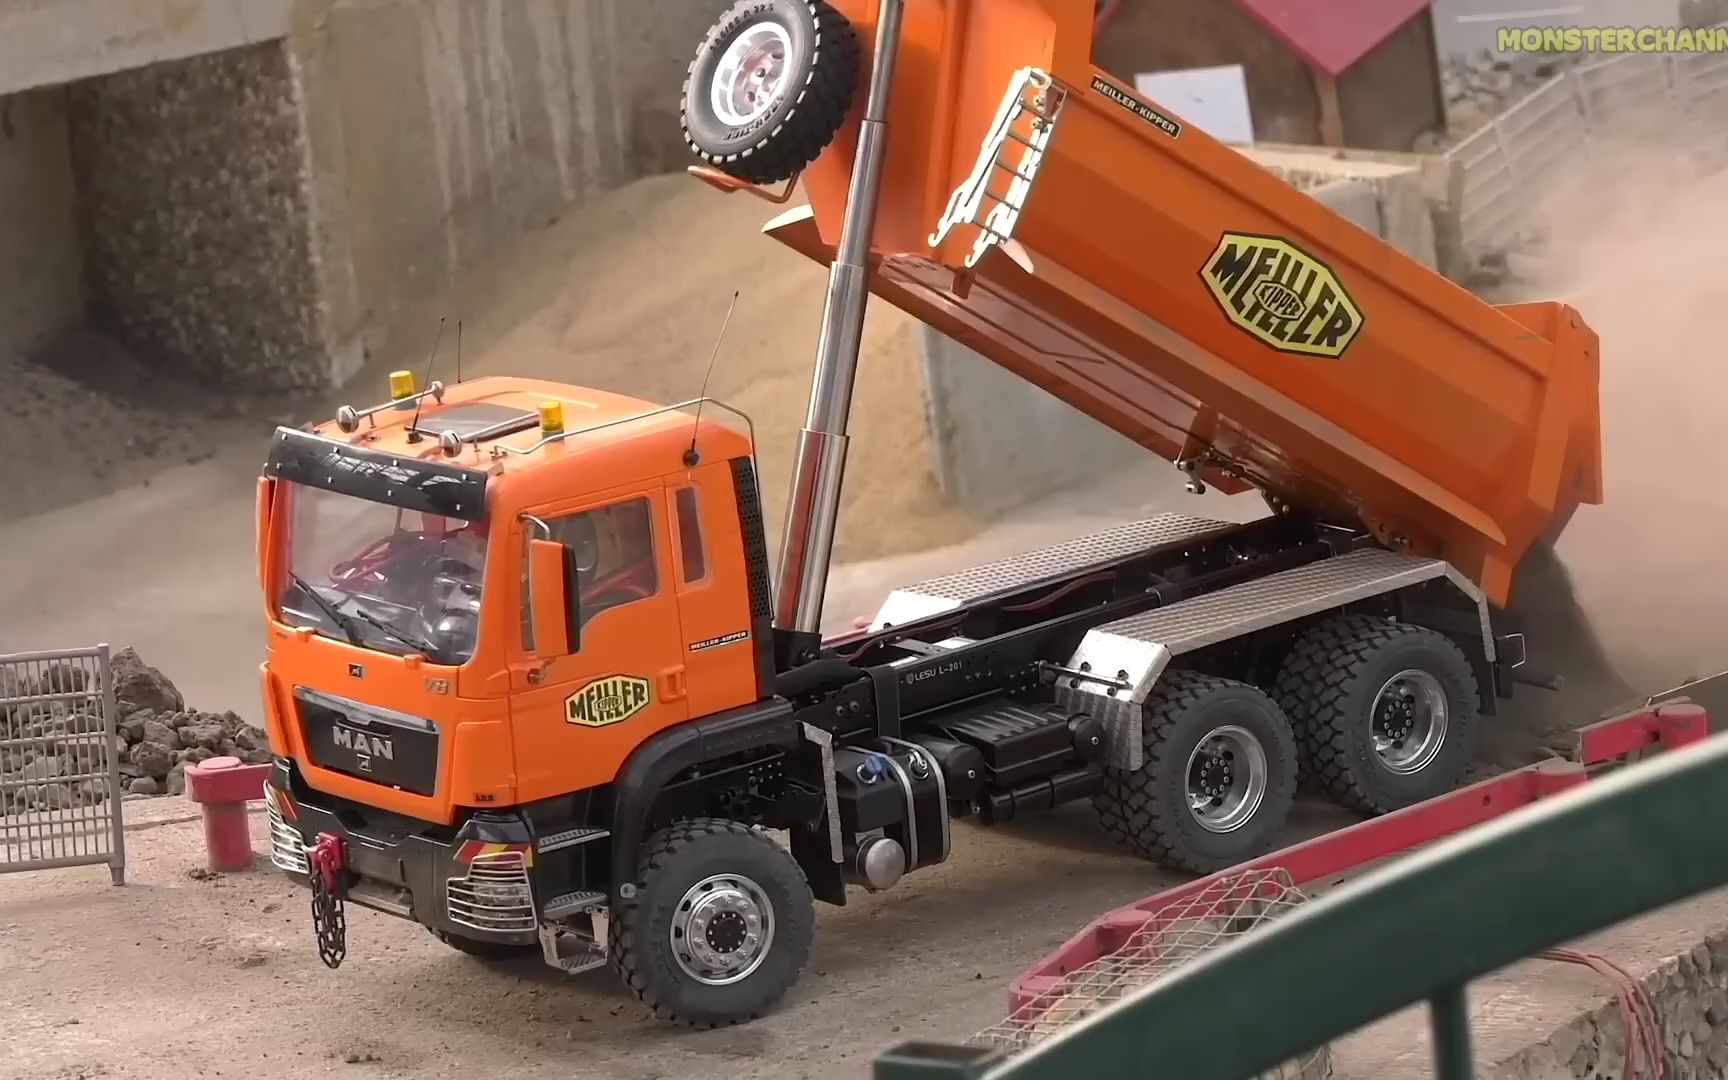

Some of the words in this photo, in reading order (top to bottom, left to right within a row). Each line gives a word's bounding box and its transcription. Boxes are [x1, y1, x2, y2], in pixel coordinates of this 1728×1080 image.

[1092, 79, 1177, 134] MEILLER-KIPPER
[1209, 243, 1353, 348] MEILLER
[1259, 284, 1302, 317] KIPPER
[690, 631, 747, 650] MEILLER-KIPPER
[938, 660, 963, 675] L-201
[569, 680, 646, 722] MEILLER
[333, 726, 394, 760] MAN
